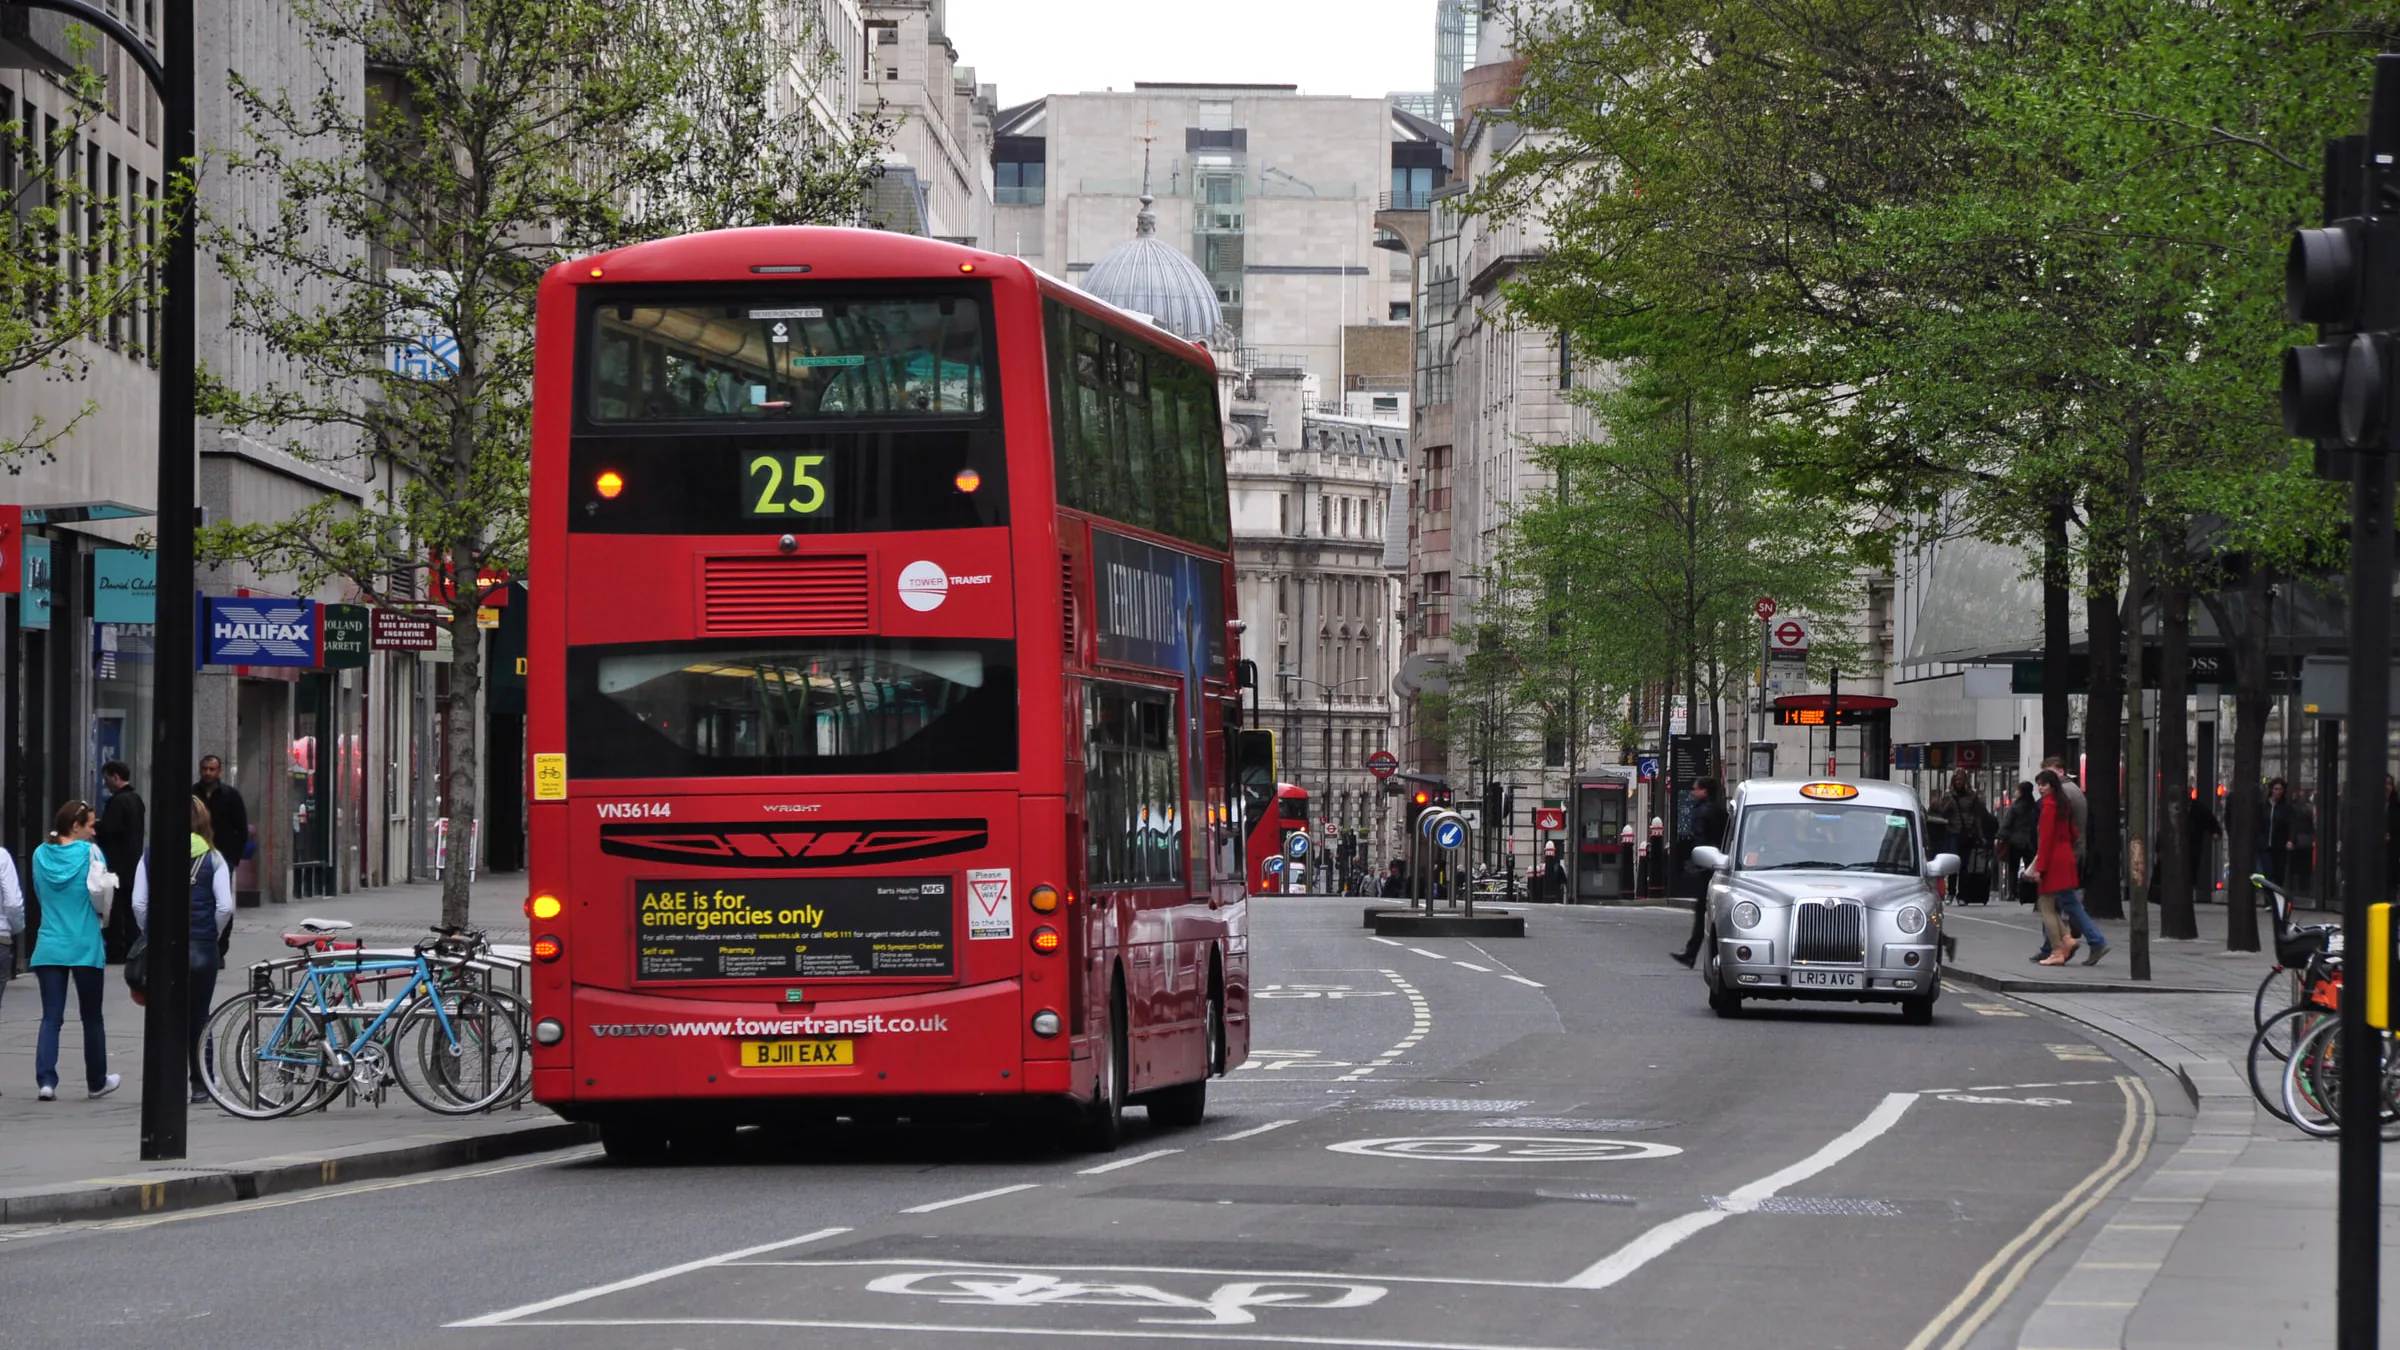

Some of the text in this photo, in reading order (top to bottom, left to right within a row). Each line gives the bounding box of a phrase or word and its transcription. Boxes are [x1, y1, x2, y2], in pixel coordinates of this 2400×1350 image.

[750, 455, 826, 514] 25
[131, 577, 156, 591] Clulo
[909, 577, 944, 587] TOWER
[949, 574, 993, 585] TRANSIT
[1757, 603, 1774, 613] SN
[378, 621, 430, 630] SHOE REPAIRS
[214, 622, 310, 641] HALIFAX
[336, 630, 346, 641] &
[383, 630, 425, 638] ENGRAVING
[375, 638, 433, 647] WATCH REPAIRS
[1812, 785, 1846, 797] TAXI
[596, 802, 672, 818] VN36144
[762, 804, 822, 812] WRIGHT
[975, 871, 1002, 879] Please
[877, 887, 895, 895] Barts
[921, 884, 945, 895] NHS
[641, 889, 746, 911] A&E is for
[642, 903, 824, 930] emergencies only
[758, 932, 800, 940] www.nhs.uk
[824, 931, 839, 939] NHS
[865, 931, 888, 940] urgent
[889, 930, 916, 938] medical
[642, 947, 657, 956] Self
[719, 946, 756, 956] Pharmacy
[795, 944, 808, 953] GP
[872, 942, 945, 952] NHS Symptom Checker
[1798, 972, 1855, 986] LR13 AVG
[589, 1024, 670, 1037] VOLVO
[670, 1013, 949, 1037] www.towertransit.co.uk
[757, 1043, 838, 1063] BJ11 EAX
